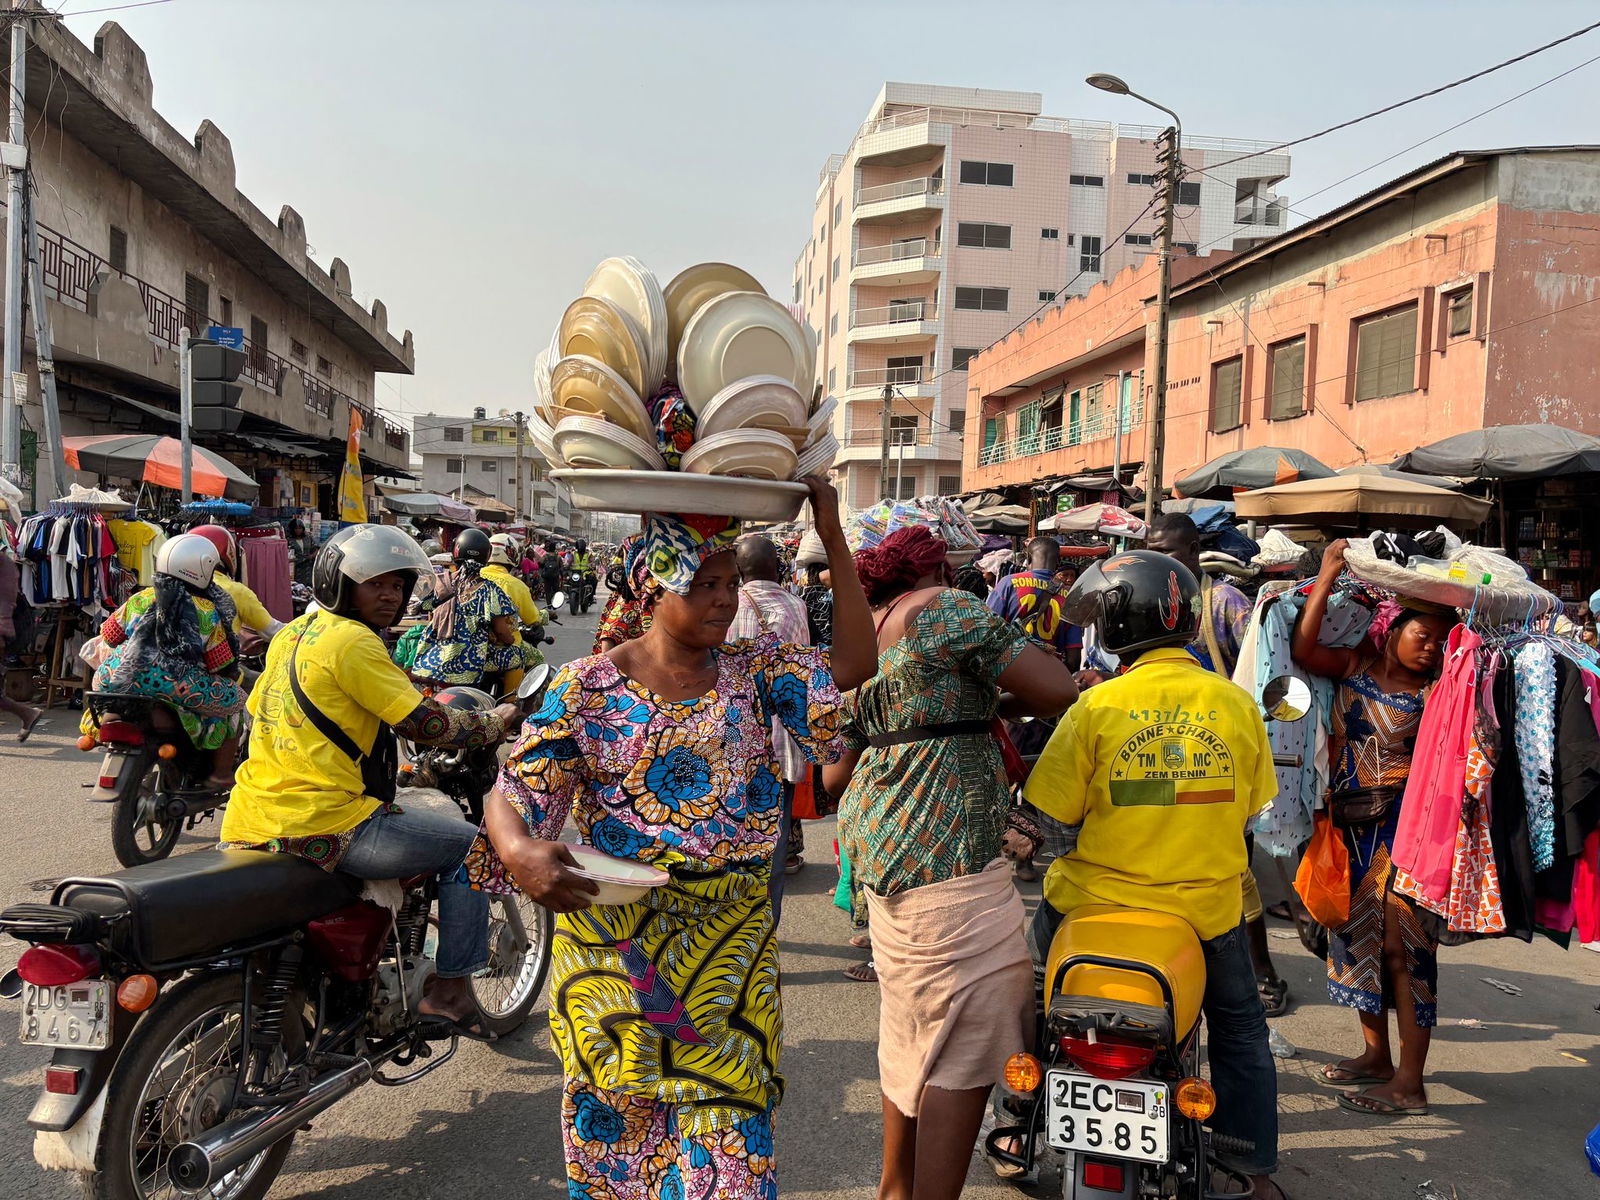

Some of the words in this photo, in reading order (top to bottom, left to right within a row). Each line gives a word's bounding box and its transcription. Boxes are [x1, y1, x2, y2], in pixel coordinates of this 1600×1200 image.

[1011, 577, 1070, 599] RONALDO
[1120, 725, 1165, 763] BONNE
[1176, 725, 1229, 761] CHANCE
[1137, 753, 1156, 768] TM
[1193, 752, 1212, 768] MC
[1144, 771, 1169, 779] ZEM
[1171, 770, 1207, 779] BENIN
[27, 985, 67, 1011] 2DG
[28, 1015, 99, 1044] 8467
[1055, 1079, 1113, 1112] 2EC
[1059, 1115, 1157, 1155] 3585
